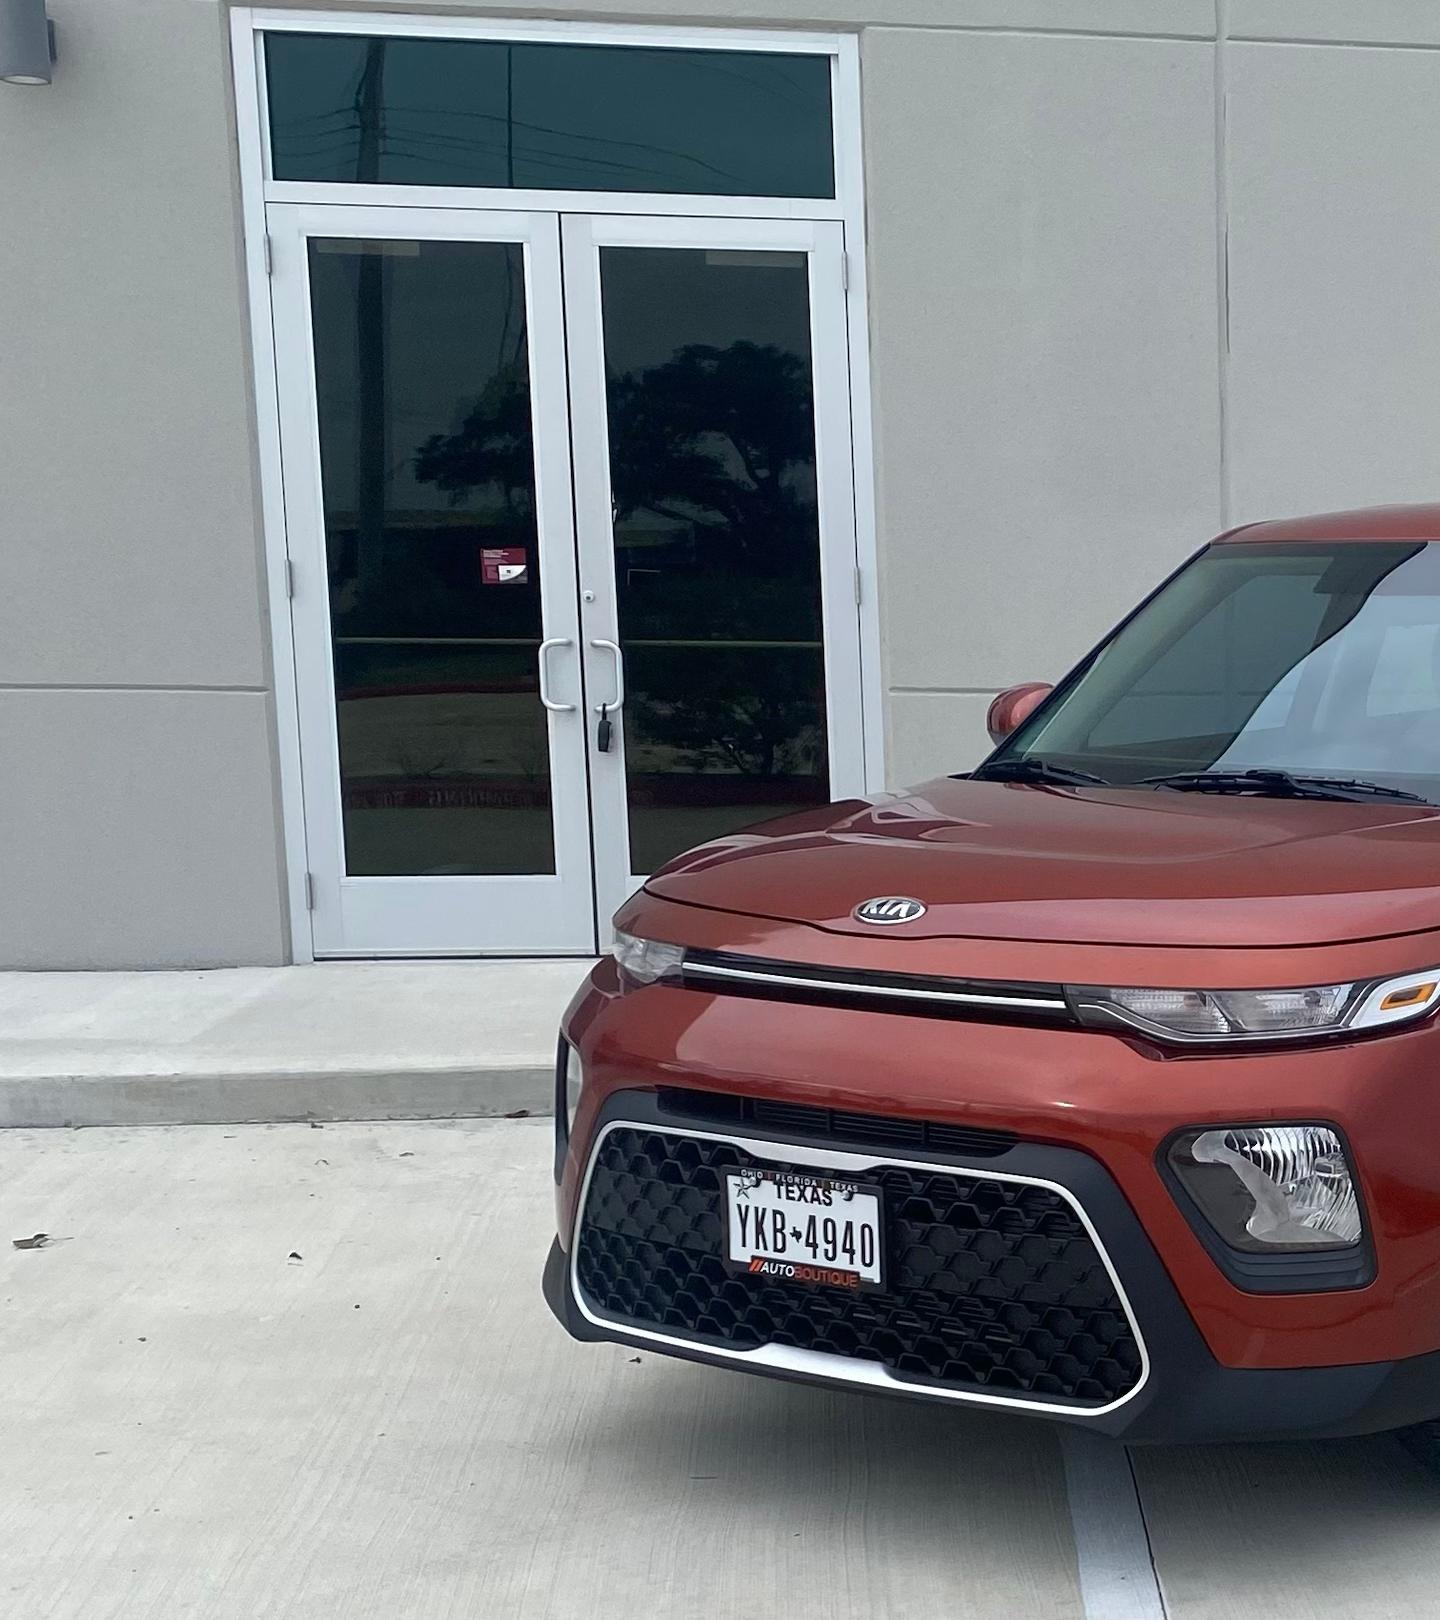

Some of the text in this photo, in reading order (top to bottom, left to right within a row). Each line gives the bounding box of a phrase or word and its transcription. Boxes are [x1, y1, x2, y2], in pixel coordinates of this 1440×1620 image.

[861, 899, 911, 918] KIA
[740, 1169, 859, 1193] OHIO FLORIDA TEXAS
[774, 1184, 833, 1207] TEXAS
